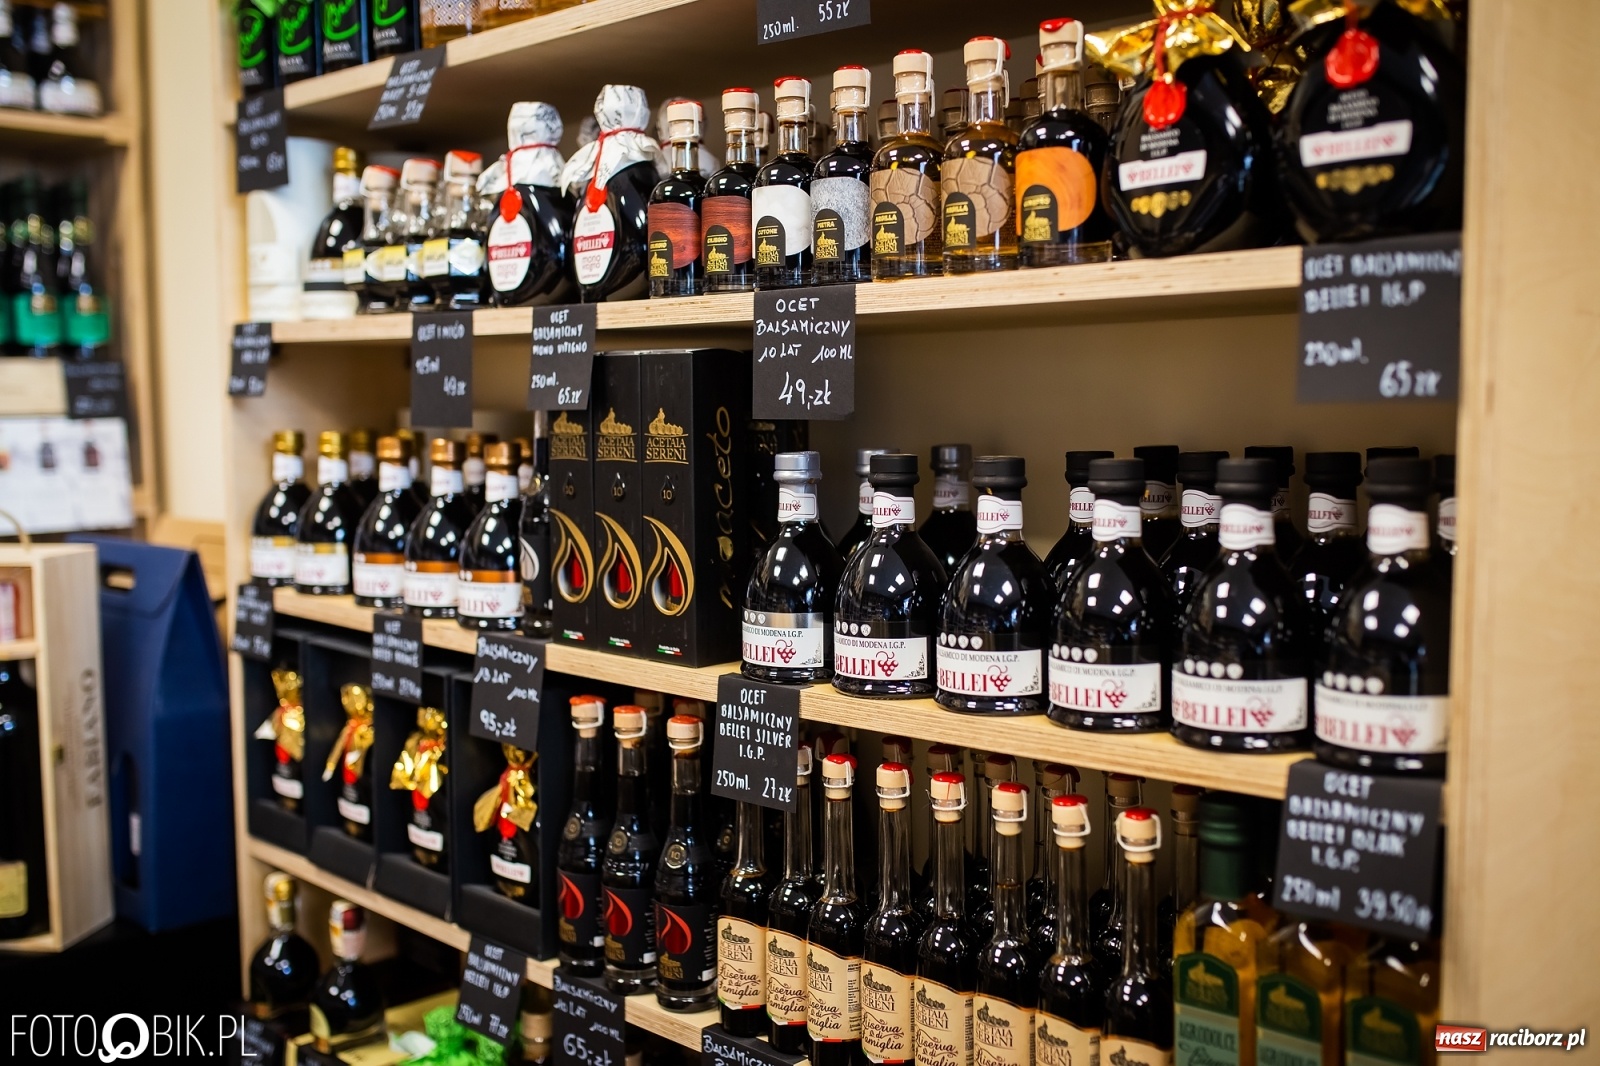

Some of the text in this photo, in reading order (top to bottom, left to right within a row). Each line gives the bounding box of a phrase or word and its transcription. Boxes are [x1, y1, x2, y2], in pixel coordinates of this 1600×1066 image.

[818, 1, 833, 22] 55
[817, 221, 835, 229] PIETRA
[775, 297, 820, 313] OCET
[550, 309, 570, 324] OCET
[757, 346, 777, 363] 10
[780, 342, 802, 358] LAT
[811, 345, 837, 364] 100
[597, 436, 635, 447] ACETAIA
[646, 437, 687, 448] ACETAIA
[597, 446, 635, 459] SERENI
[646, 448, 687, 461] SERENI
[662, 489, 673, 500] 10
[761, 627, 787, 638] MODENA
[787, 630, 804, 638] I.G.P.
[858, 640, 888, 649] MODENA
[889, 641, 906, 649] I.G.P.
[835, 652, 877, 678] BELLEI
[960, 653, 1020, 663] DI MODENA I.G.P.
[939, 667, 989, 693] BELLEI
[740, 688, 767, 706] OCET
[1051, 681, 1103, 709] BELLEI
[721, 704, 793, 732] BALSAMICZNY
[1182, 699, 1247, 728] BELLEI
[719, 722, 792, 749] BELLEI SILVER
[739, 744, 766, 761] I.G.P.
[762, 776, 777, 799] 27
[719, 963, 759, 981] Riserva
[861, 1012, 902, 1034] Riserva
[915, 1029, 957, 1052] Riserva
